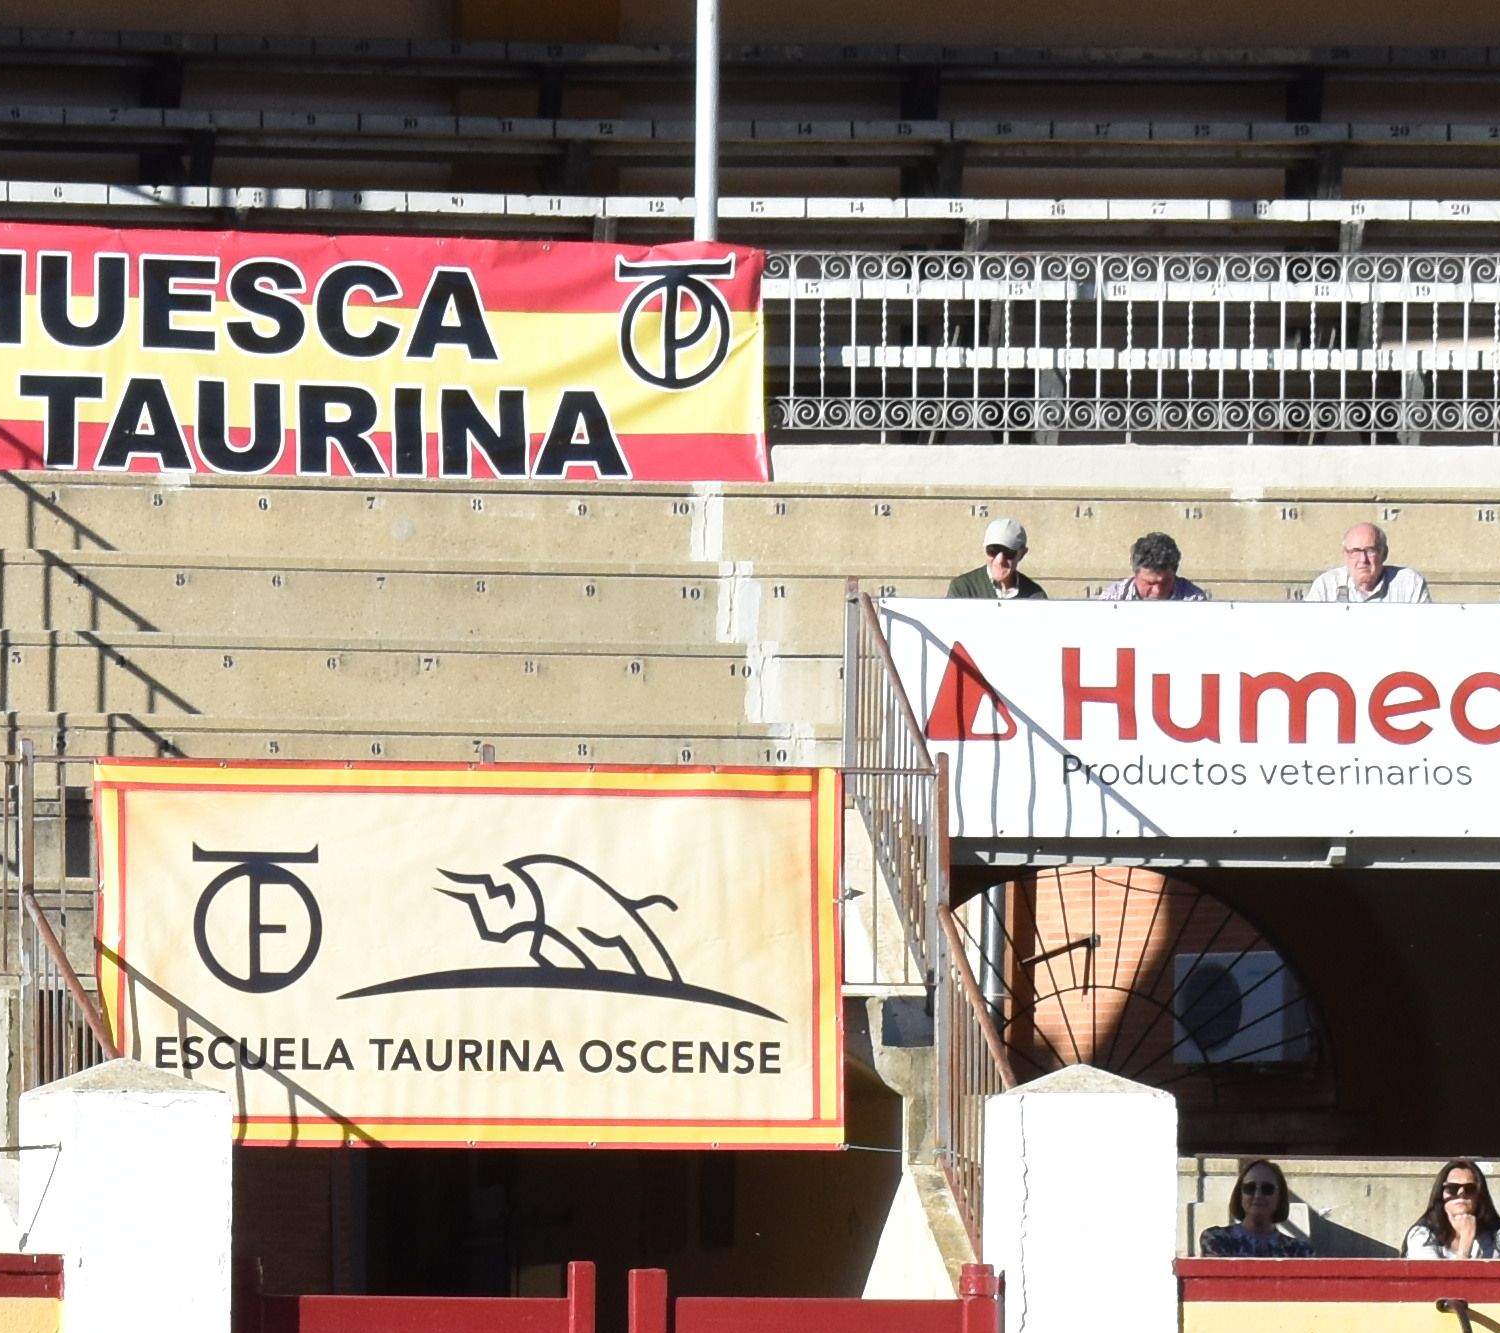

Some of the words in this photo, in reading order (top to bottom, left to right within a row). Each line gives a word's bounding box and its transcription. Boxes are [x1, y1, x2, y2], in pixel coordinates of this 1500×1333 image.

[20, 375, 631, 481] TAURINA
[1062, 755, 1247, 787] Productos
[1260, 757, 1473, 787] veterinarios
[155, 1036, 354, 1072] ESCUELA
[369, 1038, 566, 1073] TAURINA
[579, 1040, 782, 1075] OSCENSE
